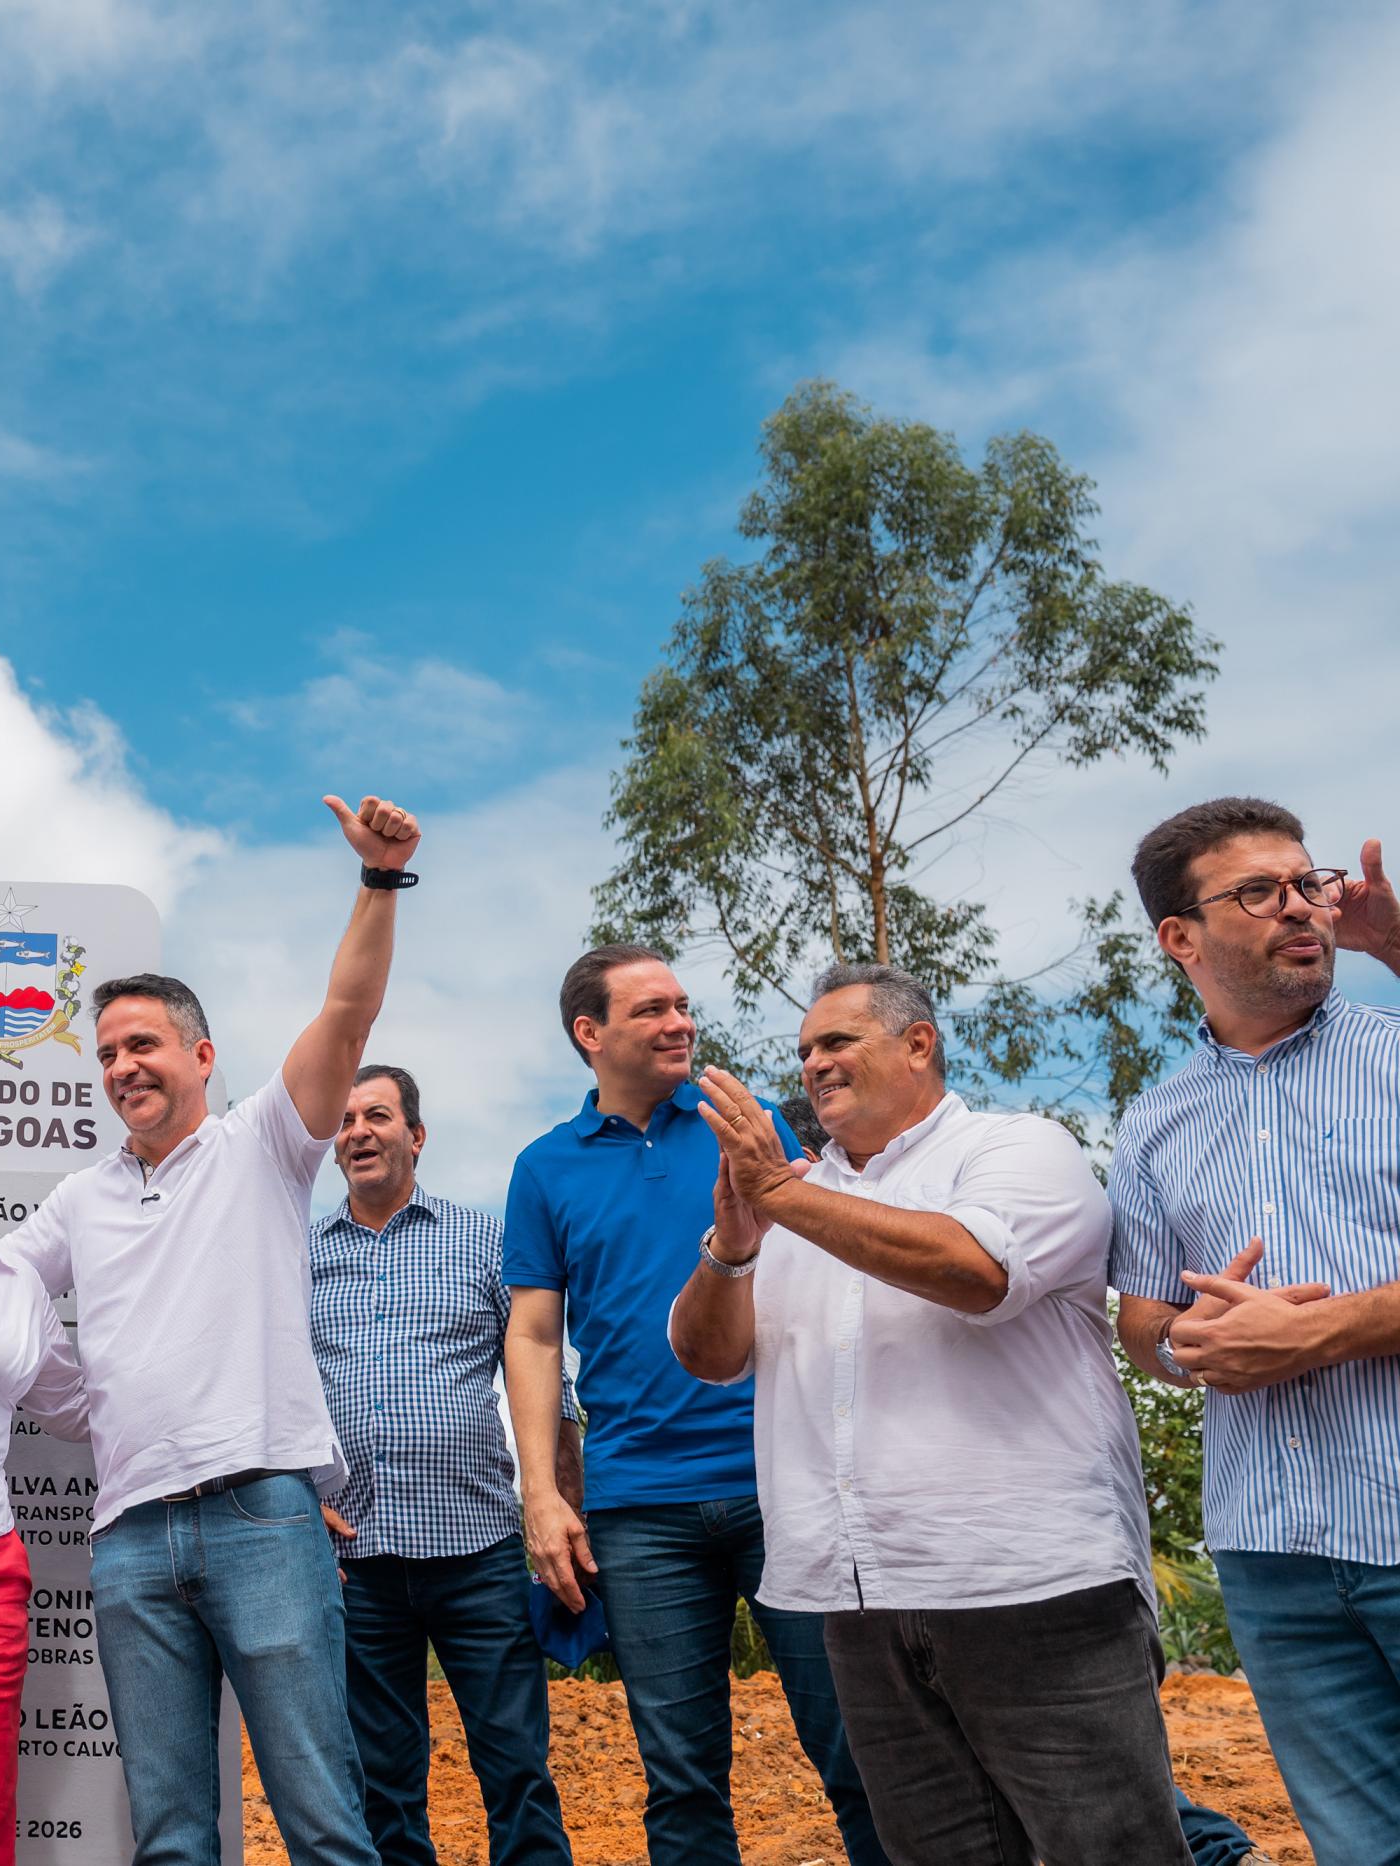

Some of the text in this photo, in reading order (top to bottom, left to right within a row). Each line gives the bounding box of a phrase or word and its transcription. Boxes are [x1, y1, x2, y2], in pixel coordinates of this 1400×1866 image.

[52, 1081, 93, 1108] DE
[5, 1476, 57, 1495] LVA
[21, 1530, 90, 1546] TO UR
[28, 1617, 93, 1639] ENO
[27, 1648, 94, 1665] OBRAS
[36, 1703, 108, 1730] LEÃO
[27, 1820, 82, 1839] 2026
